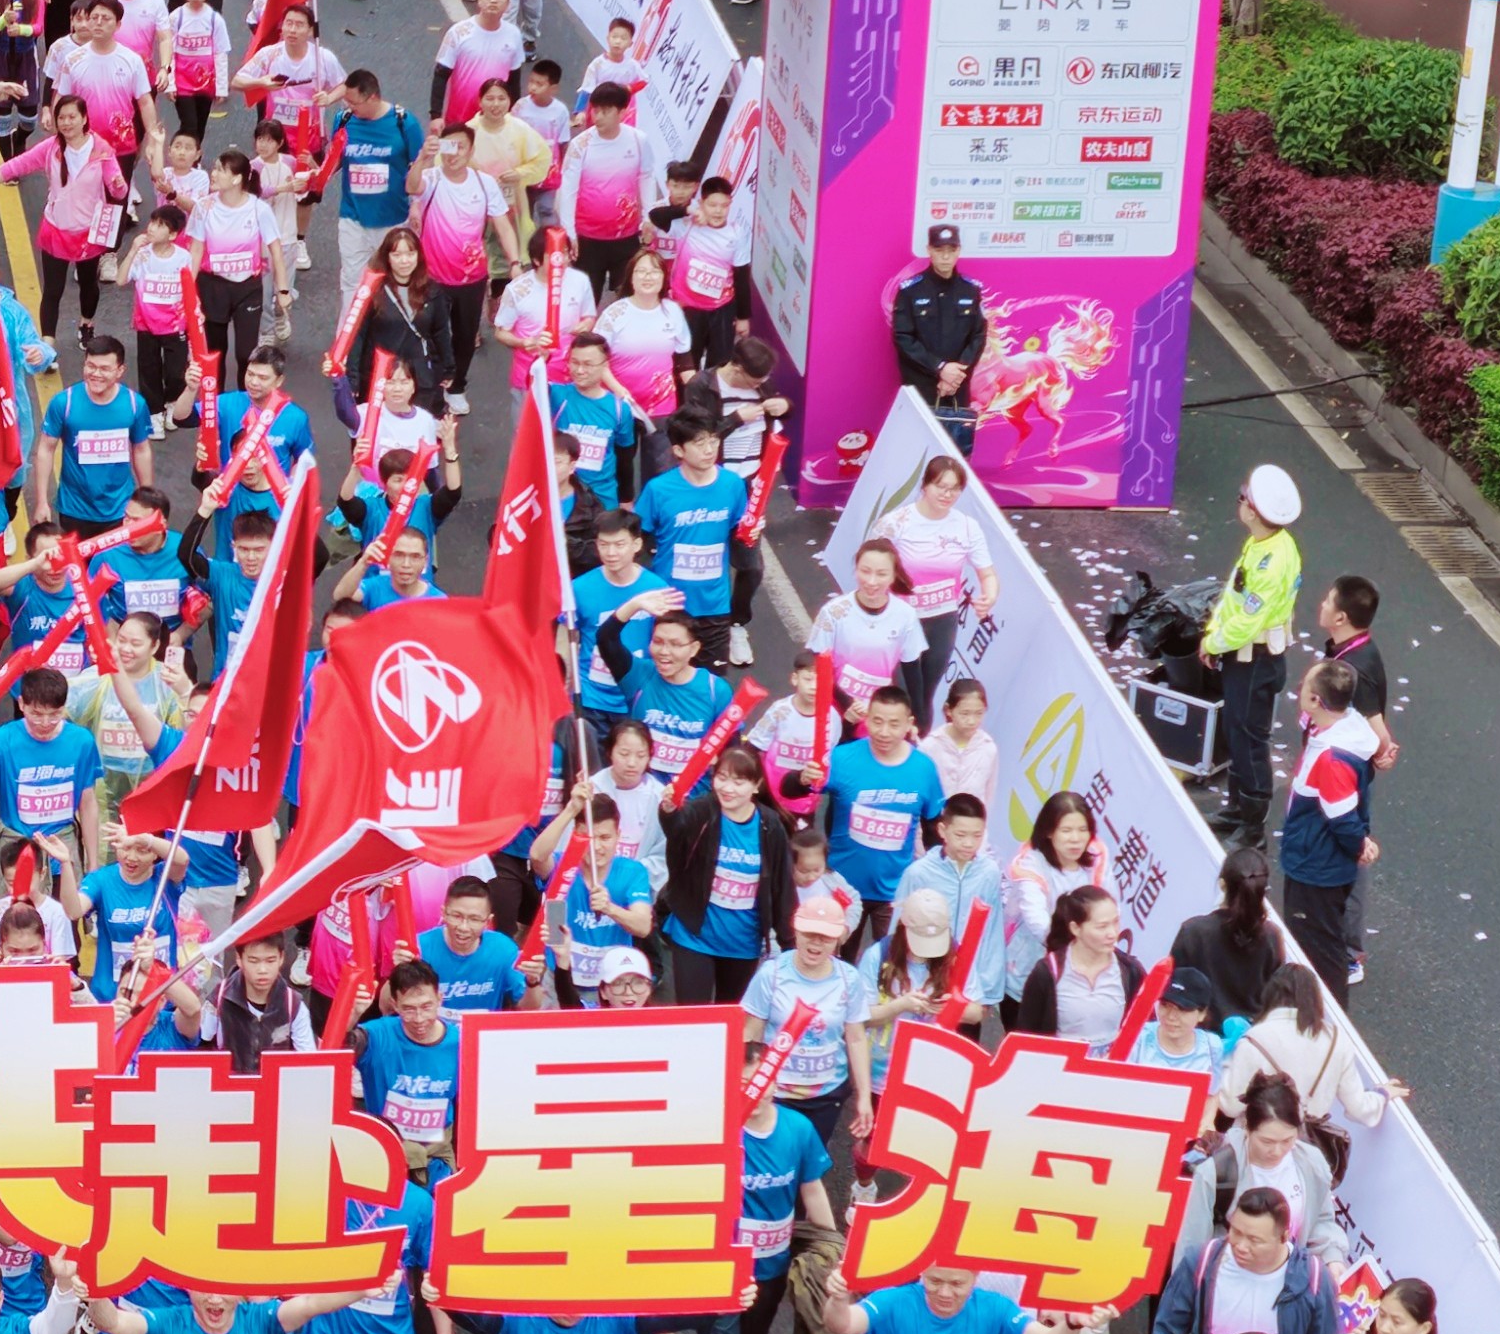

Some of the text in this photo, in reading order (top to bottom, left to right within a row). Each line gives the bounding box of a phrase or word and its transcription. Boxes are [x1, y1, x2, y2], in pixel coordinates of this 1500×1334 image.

[1101, 62, 1182, 79] 东风柳汽
[1078, 107, 1162, 123] 京东运动
[969, 138, 1008, 153] 采乐
[1085, 141, 1148, 158] 农夫山泉
